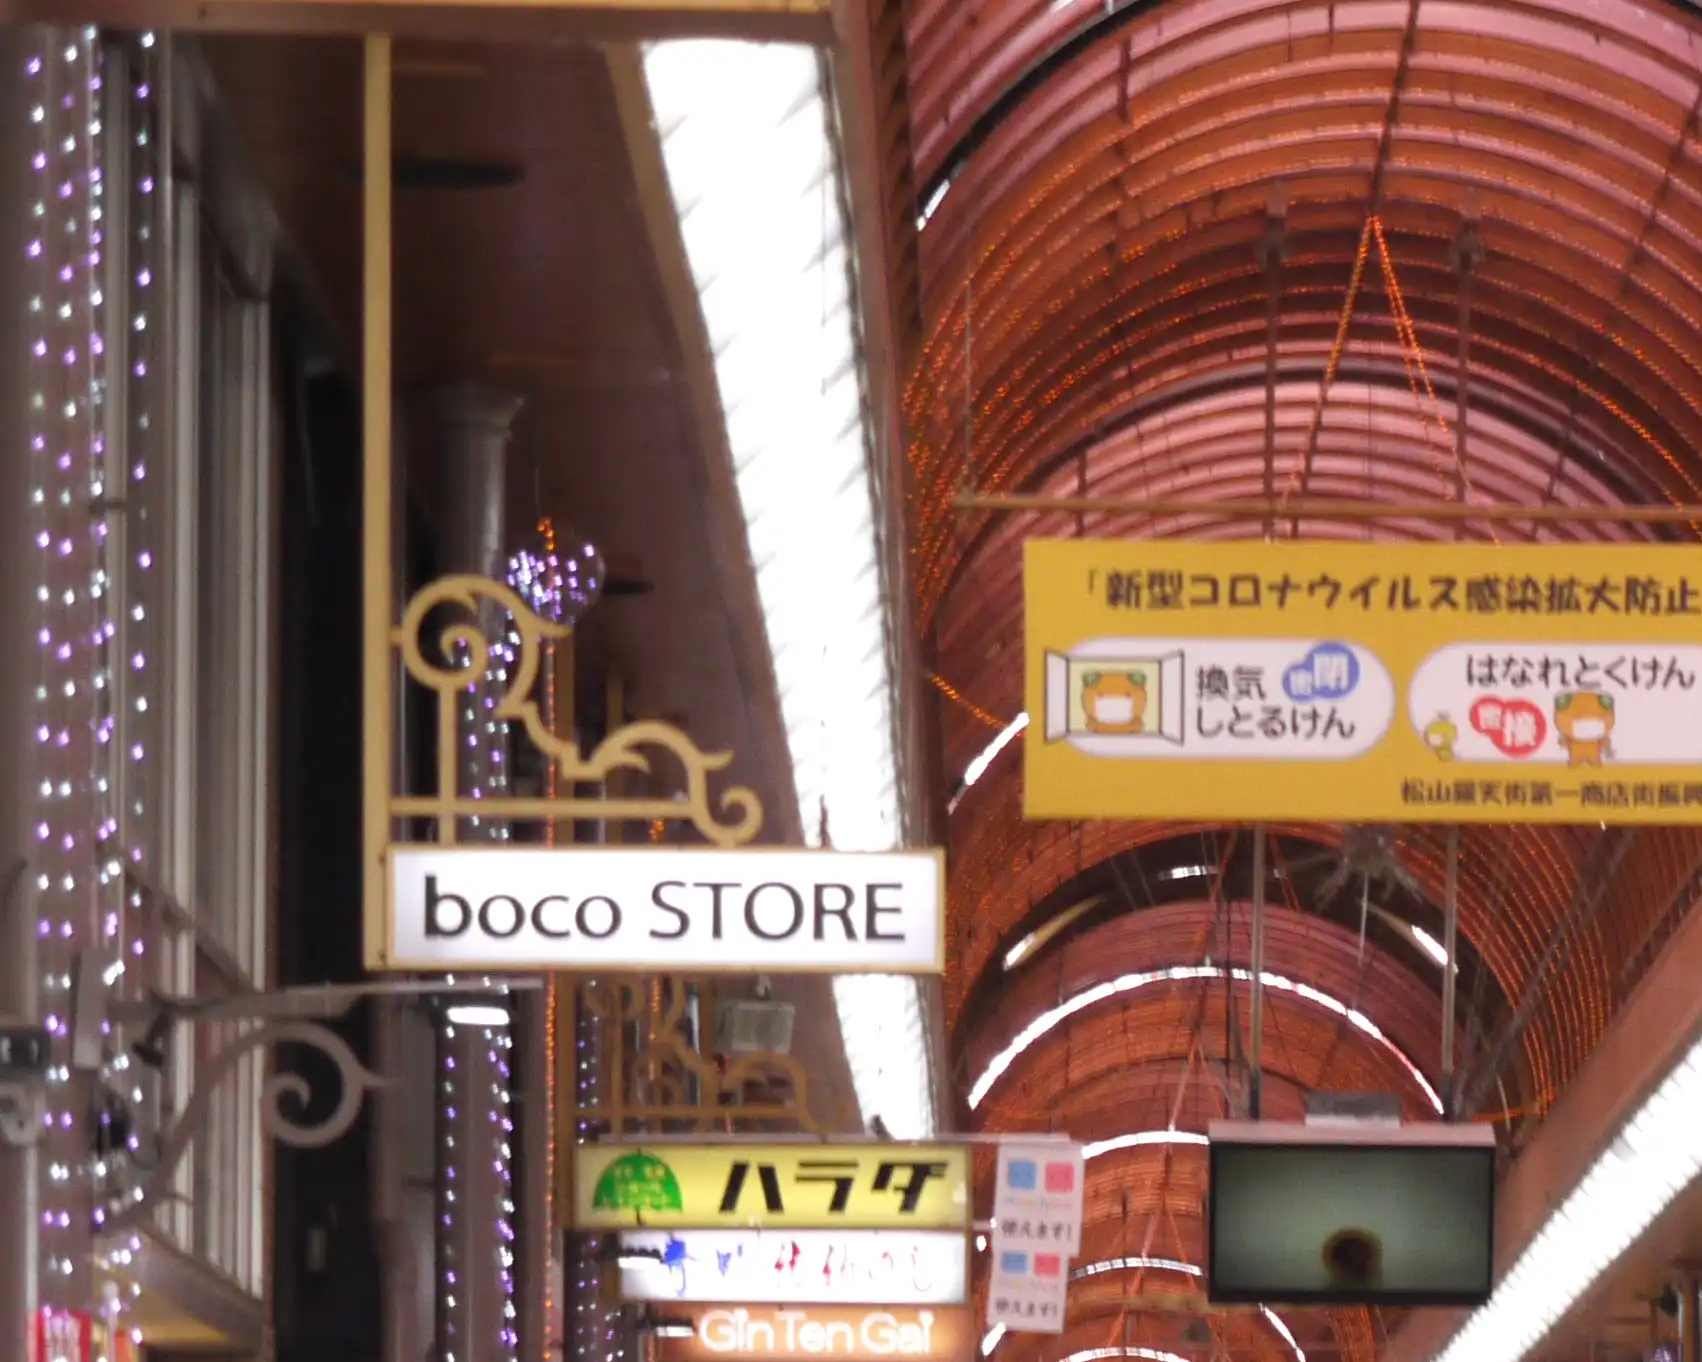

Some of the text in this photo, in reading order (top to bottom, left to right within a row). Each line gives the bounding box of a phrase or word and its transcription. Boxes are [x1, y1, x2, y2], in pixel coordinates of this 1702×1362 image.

[1195, 666, 1267, 702] 換気
[1465, 652, 1696, 691] はなれとくけん
[1195, 704, 1356, 740] しとるけん
[423, 874, 906, 942] boco STORE
[700, 1309, 774, 1353] Gin
